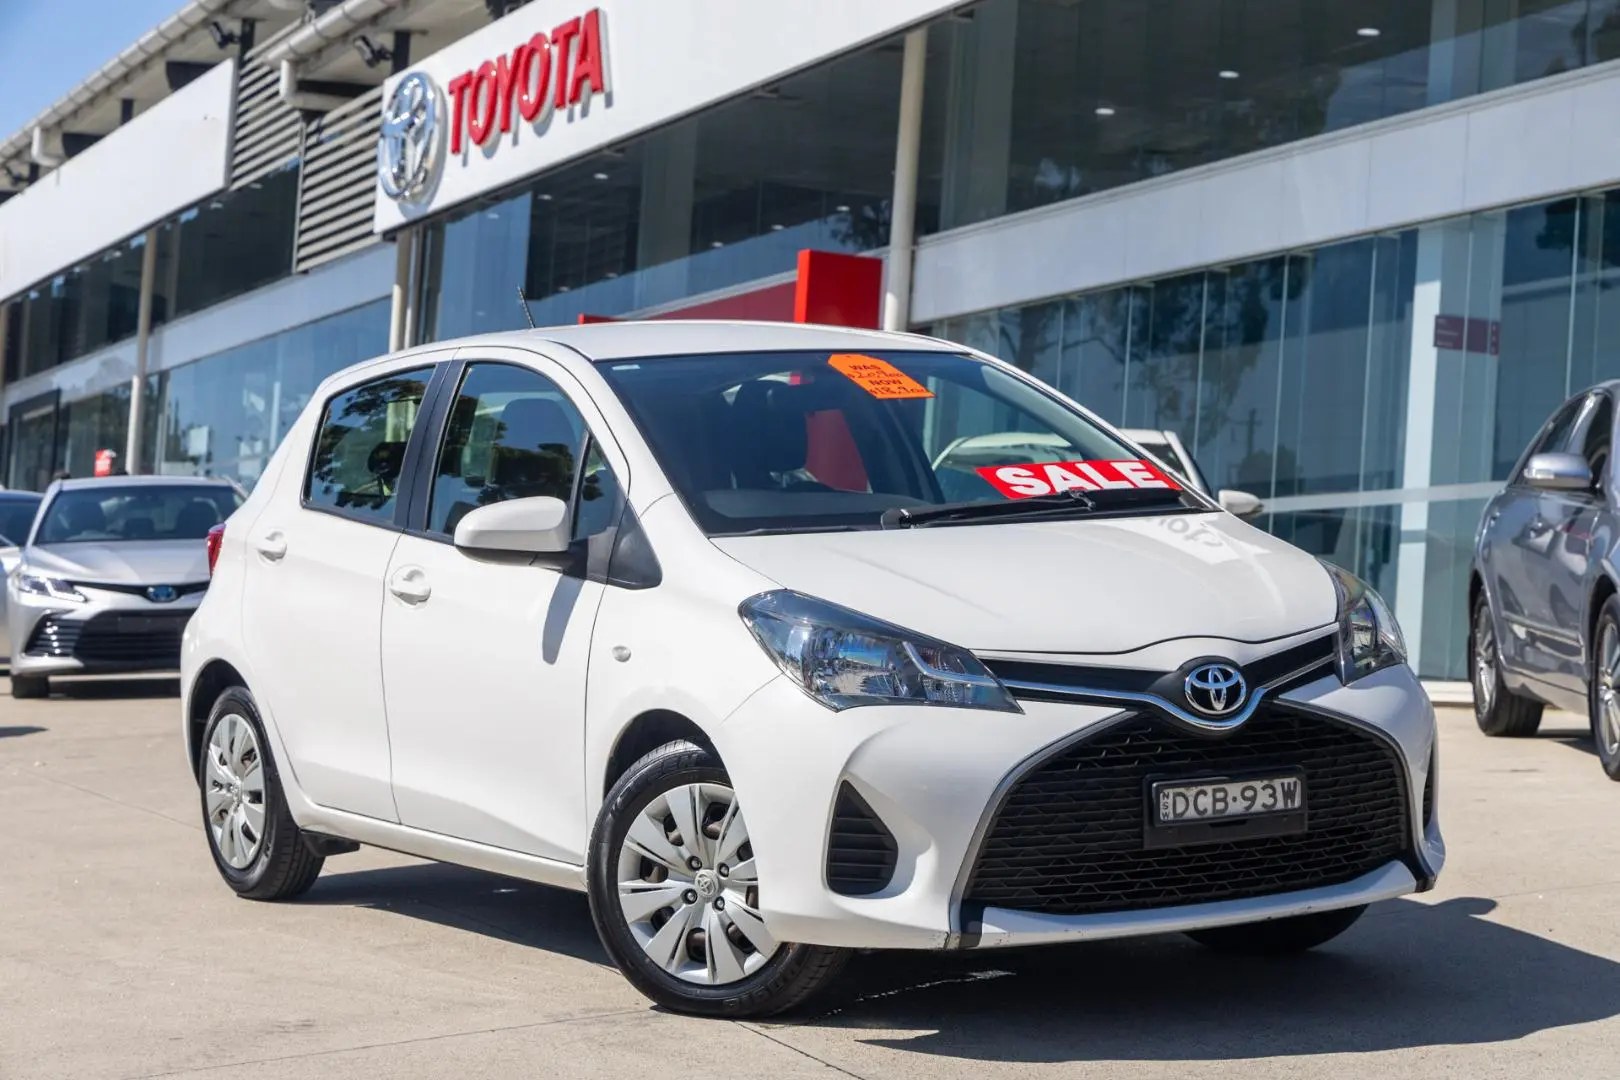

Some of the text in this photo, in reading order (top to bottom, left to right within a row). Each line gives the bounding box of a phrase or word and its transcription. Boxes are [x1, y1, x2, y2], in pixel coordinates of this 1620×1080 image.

[448, 8, 604, 156] TOYOTA
[995, 461, 1169, 496] SALE
[1161, 791, 1170, 820] NSW
